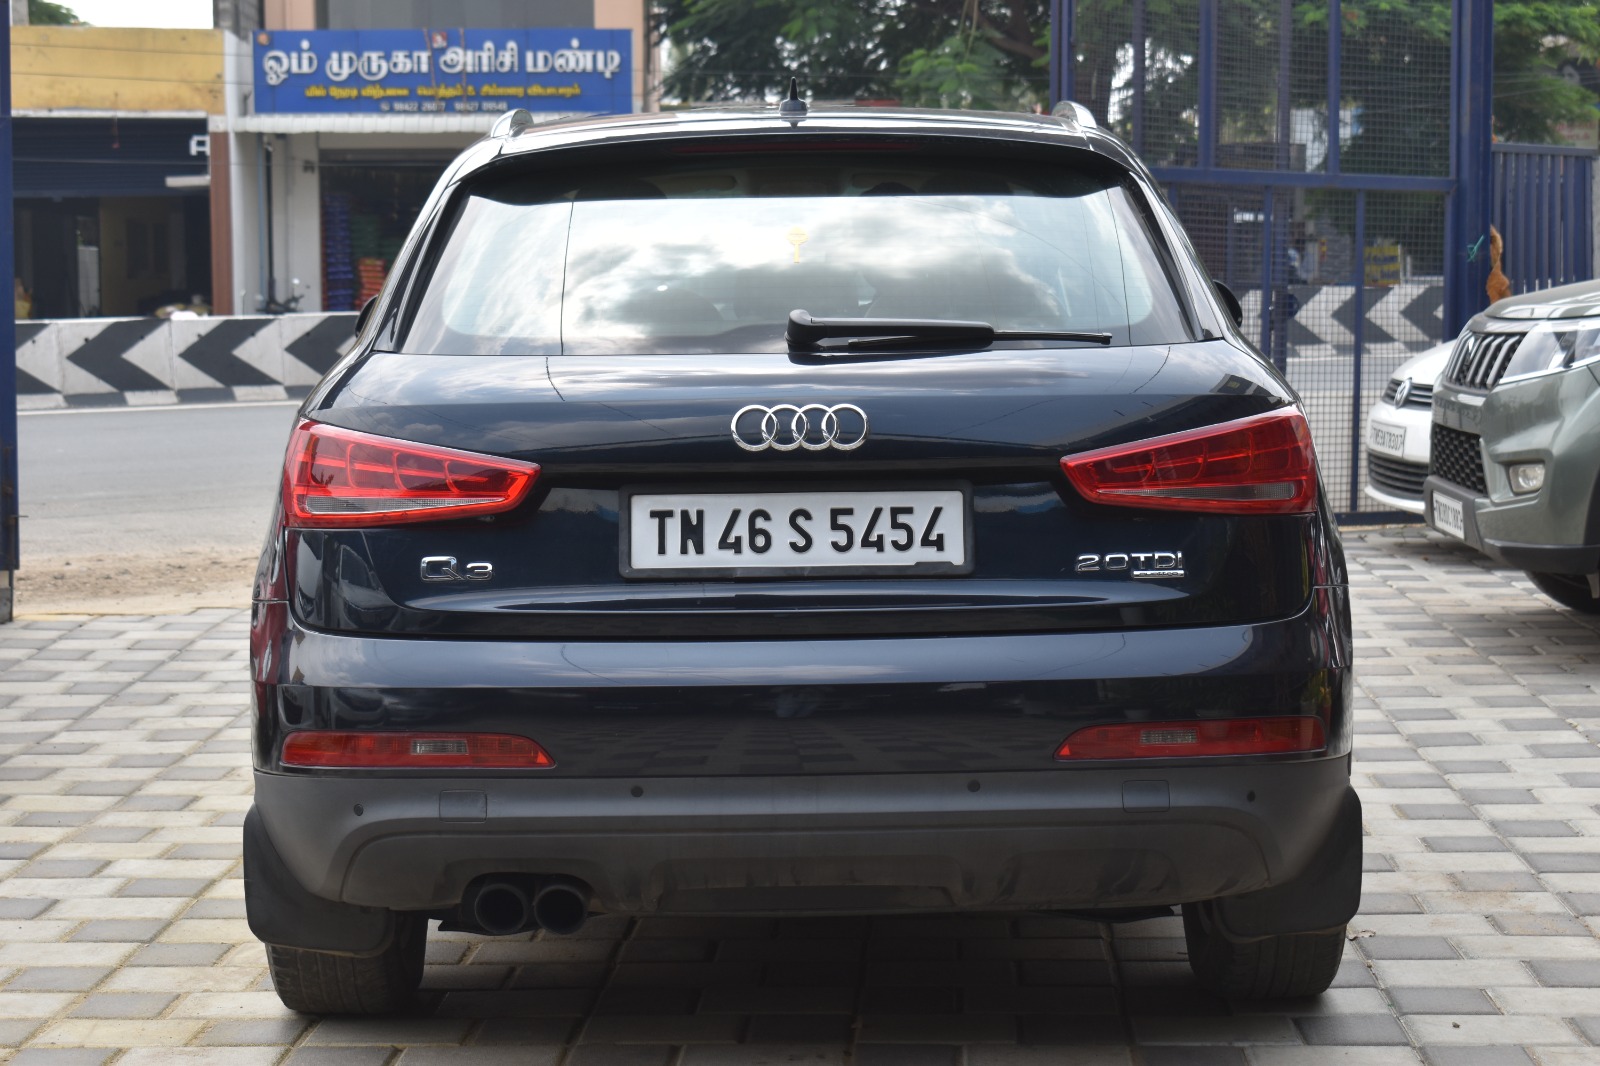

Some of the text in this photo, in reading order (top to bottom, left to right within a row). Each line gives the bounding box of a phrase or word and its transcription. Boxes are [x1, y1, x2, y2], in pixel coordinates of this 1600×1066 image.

[263, 37, 621, 85] ஓம் முருகா அரிசி மண்டி
[649, 506, 945, 555] TN 46 S 5454
[421, 556, 493, 581] Q3
